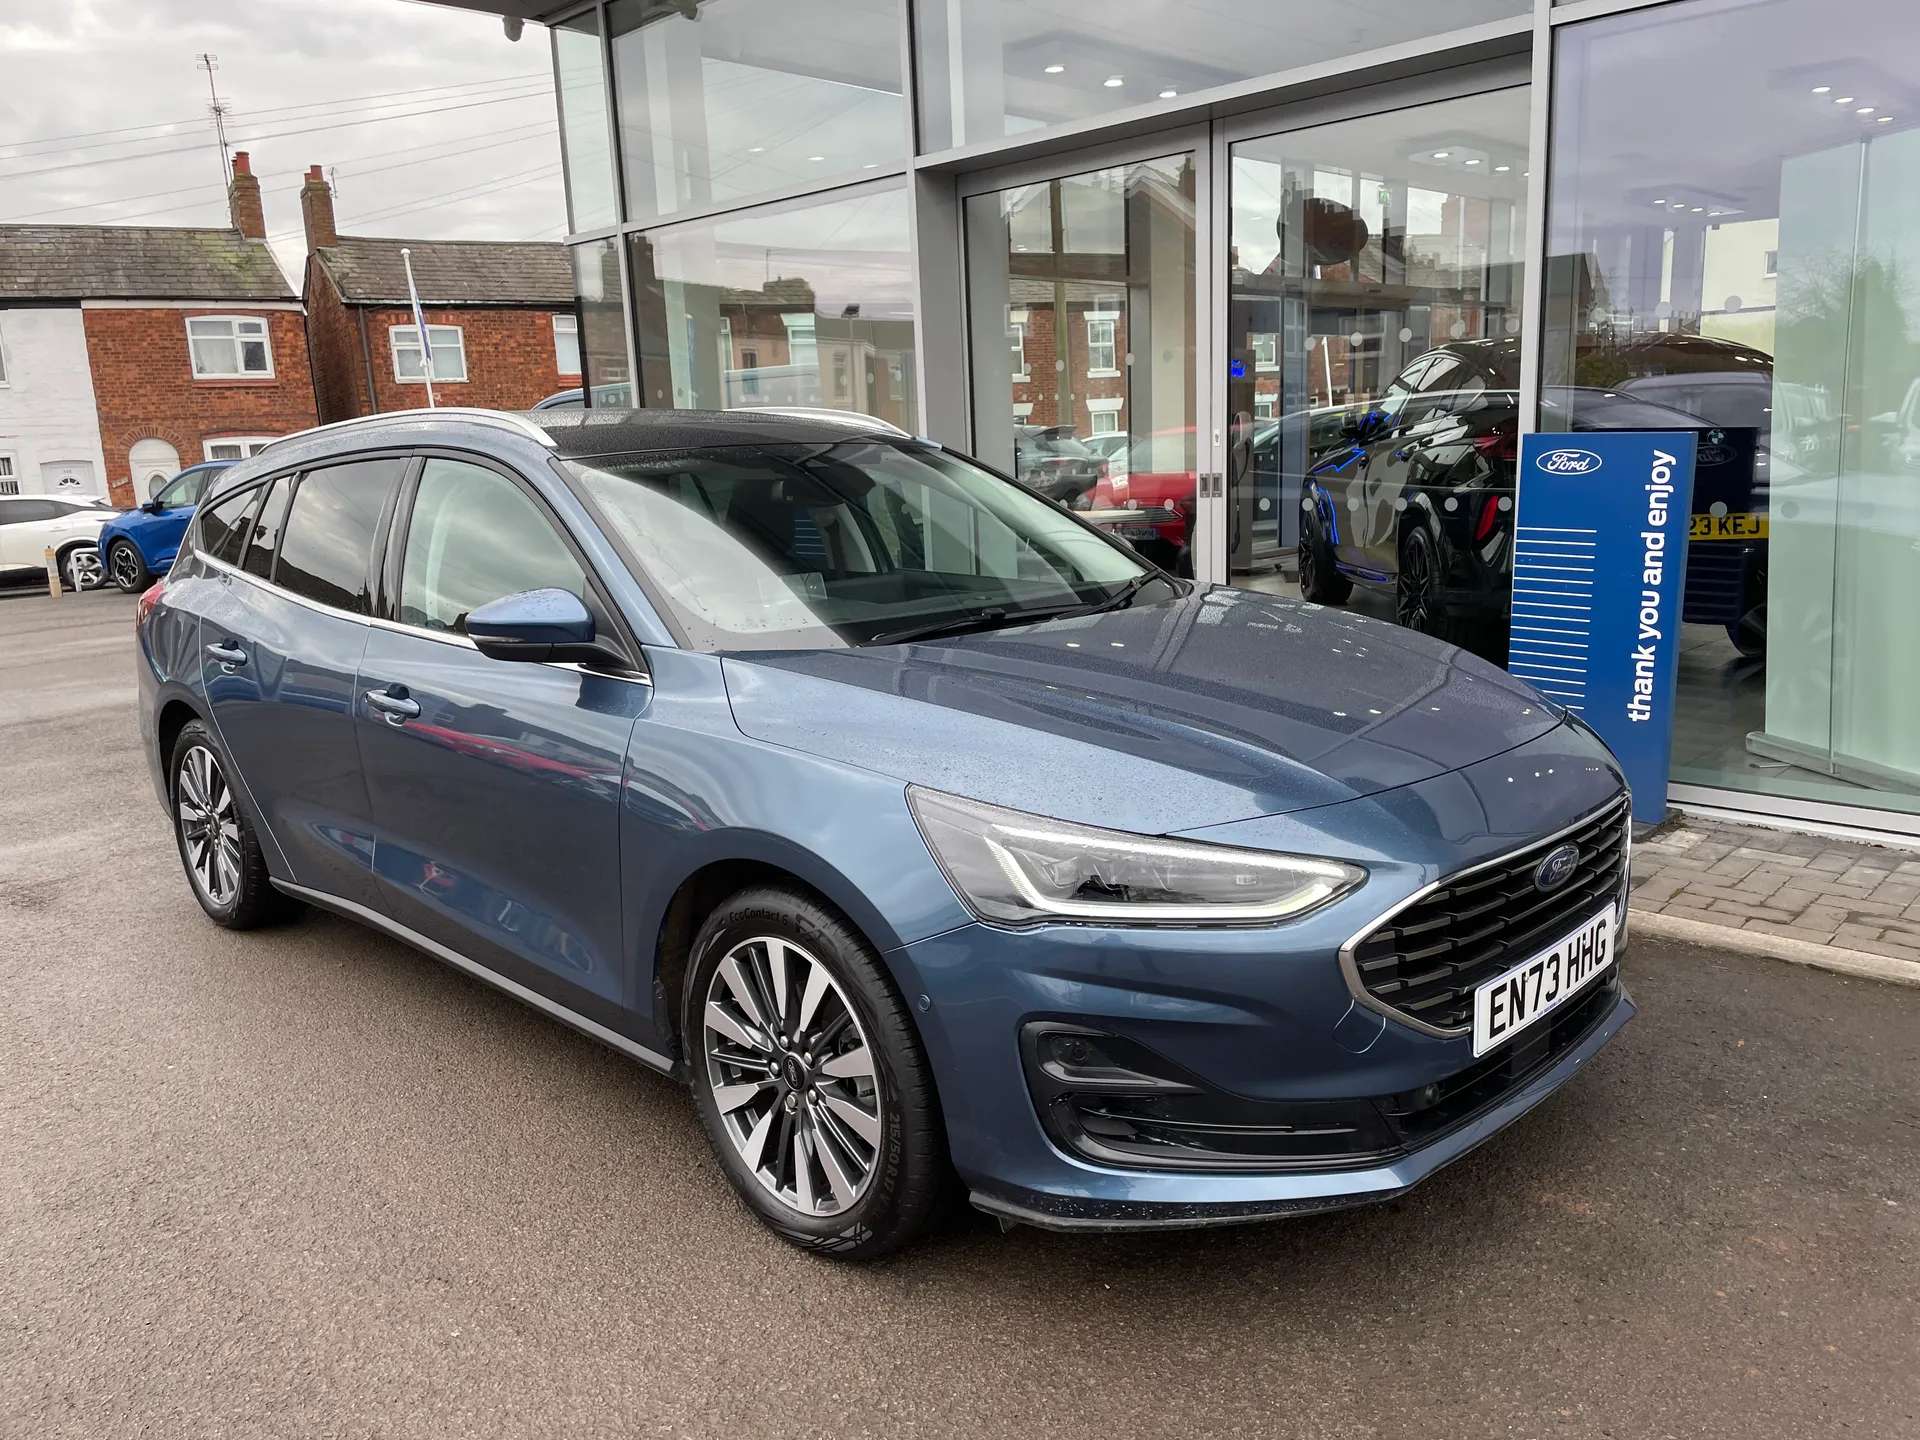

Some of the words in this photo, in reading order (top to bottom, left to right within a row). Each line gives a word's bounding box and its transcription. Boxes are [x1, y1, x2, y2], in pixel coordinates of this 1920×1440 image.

[1547, 452, 1591, 471] Ford
[1645, 449, 1677, 527] enjoy
[1718, 515, 1760, 536] KEJ
[1641, 531, 1665, 586] and
[1638, 590, 1661, 640] you
[1627, 644, 1656, 722] thank
[1489, 952, 1561, 1040] EN73
[1566, 918, 1607, 990] HHG
